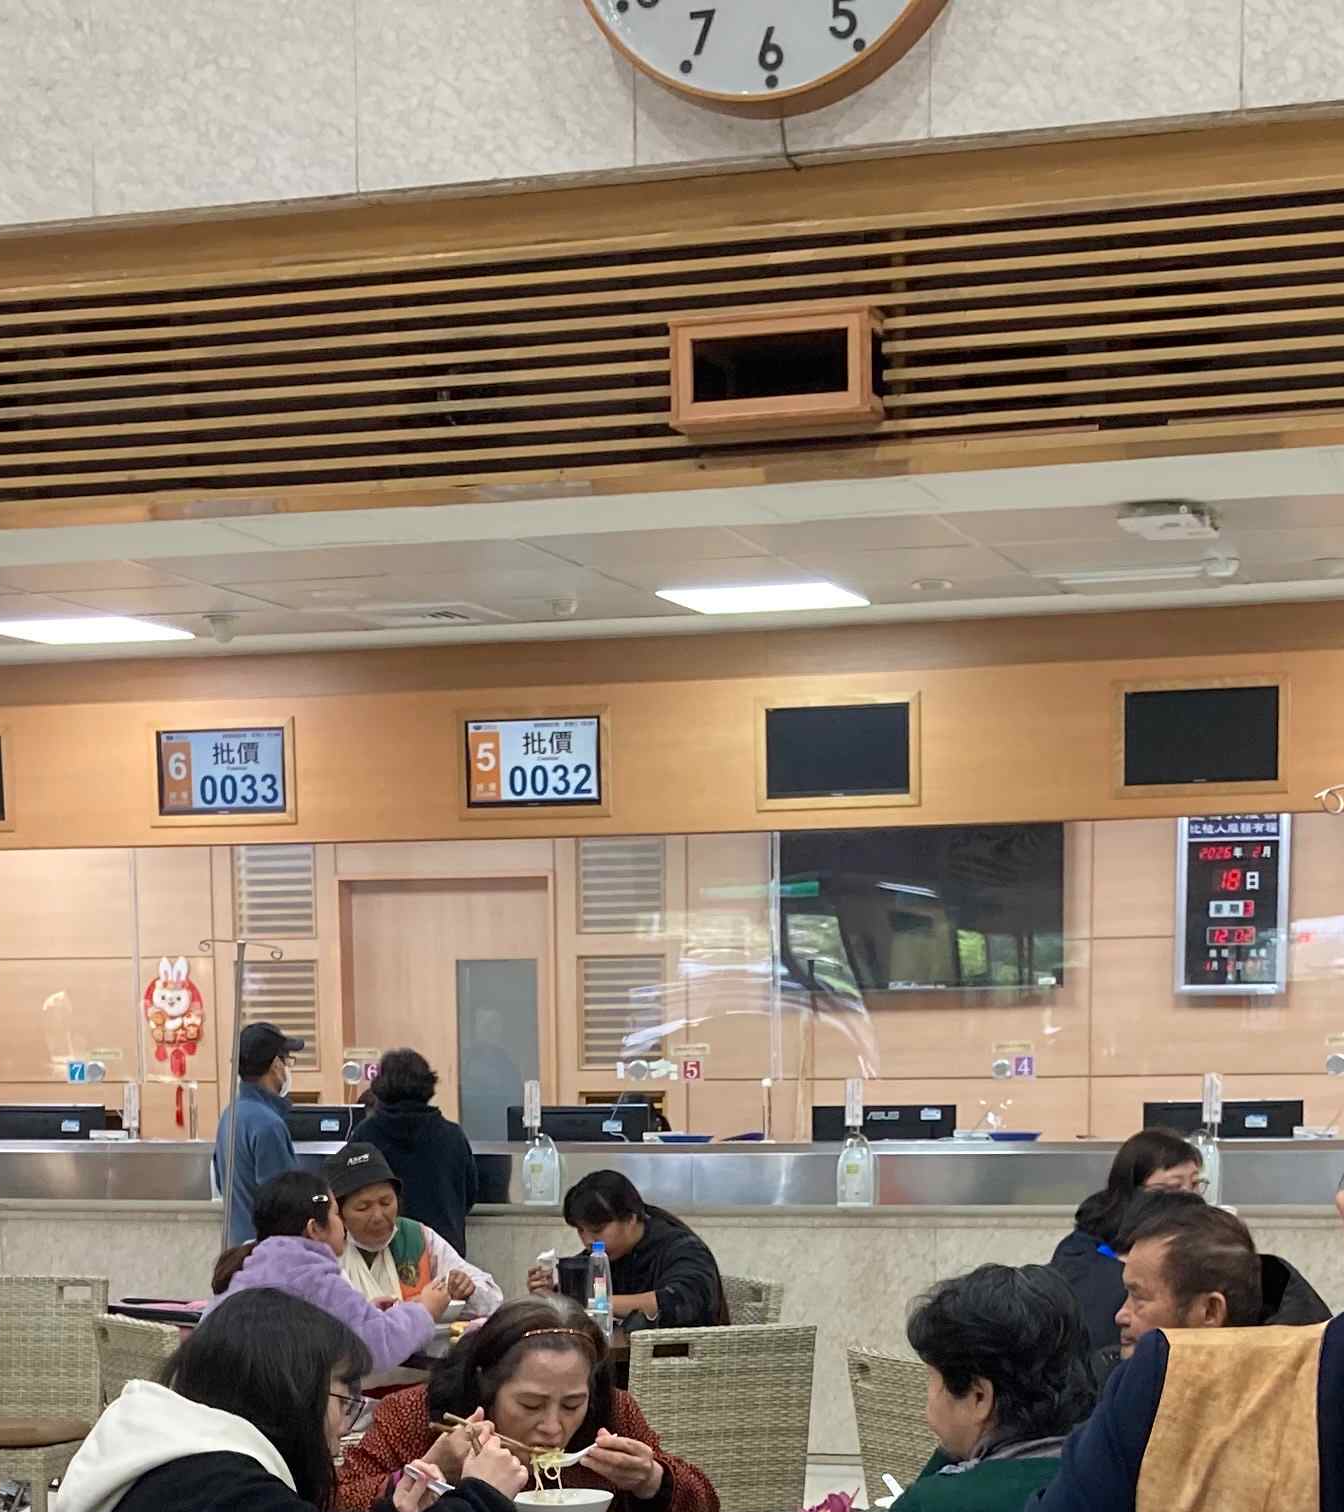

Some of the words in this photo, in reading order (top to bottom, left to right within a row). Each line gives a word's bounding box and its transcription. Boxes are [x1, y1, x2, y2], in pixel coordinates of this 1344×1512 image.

[689, 8, 716, 56] 7
[829, 0, 857, 39] 5
[758, 26, 784, 71] 6
[212, 742, 260, 765] 批價
[522, 731, 574, 755] 批價
[168, 752, 187, 780] 6
[475, 742, 496, 772] 5
[199, 773, 279, 805] 0033
[509, 763, 592, 796] 0032
[71, 1063, 83, 1080] 7
[366, 1064, 378, 1080] 6
[685, 1062, 699, 1079] 5
[1017, 1057, 1032, 1075] 4
[867, 1111, 900, 1120] ASUS
